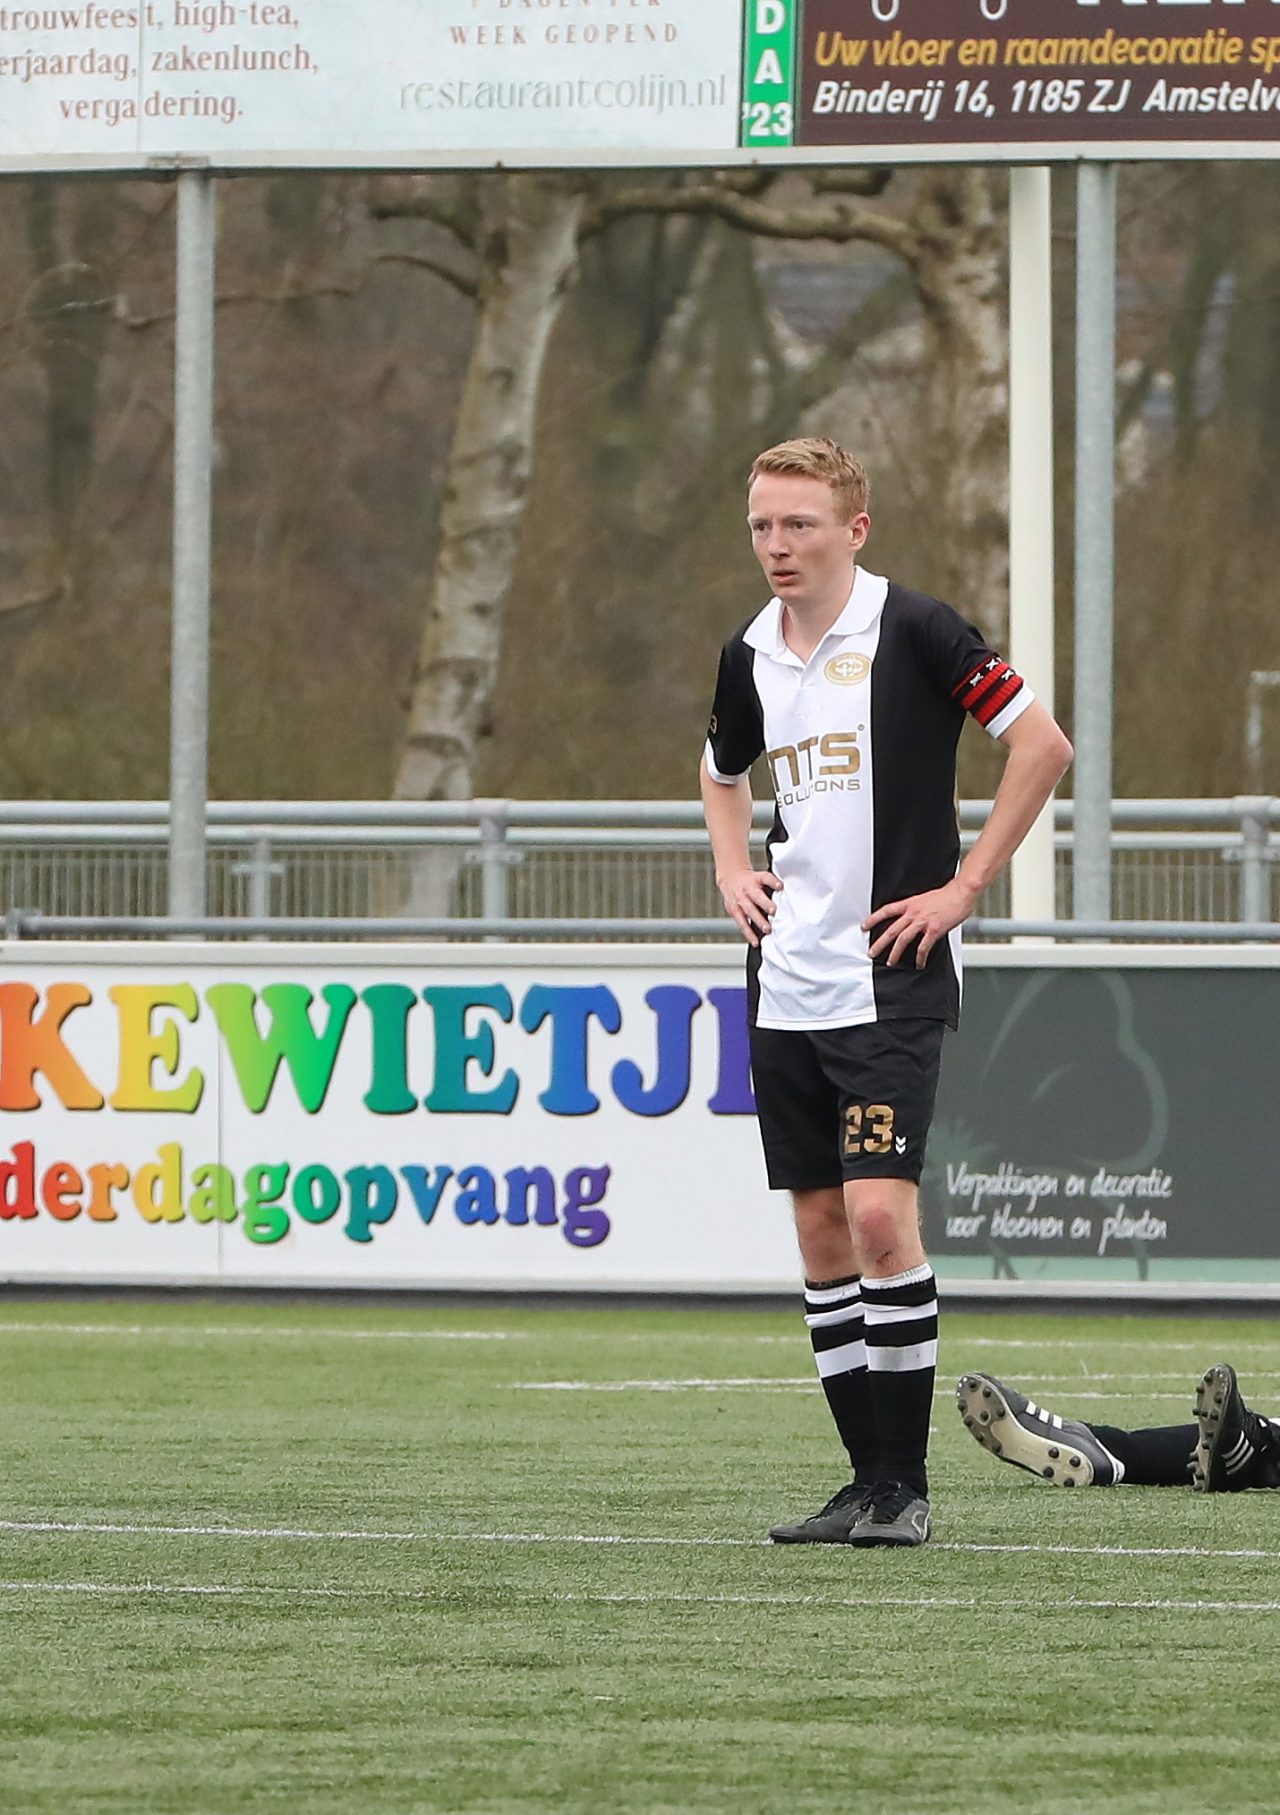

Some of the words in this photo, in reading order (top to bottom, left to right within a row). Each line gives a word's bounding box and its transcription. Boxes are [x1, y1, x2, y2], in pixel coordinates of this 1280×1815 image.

[173, 0, 299, 33] high-tea,
[450, 25, 526, 44] WEEK
[545, 23, 677, 44] GEOPEND
[151, 44, 319, 73] zakenlunch,
[815, 31, 868, 67] Uw
[872, 30, 953, 66] vloer
[957, 38, 998, 66] en
[1003, 28, 1243, 66] raamdecoratie
[401, 75, 726, 114] restaurantcolijn.nl
[812, 80, 945, 121] Binderij
[953, 79, 995, 118] 16,
[1010, 79, 1085, 113] 1185
[1087, 79, 1132, 112] ZJ
[844, 1104, 894, 1156] 23
